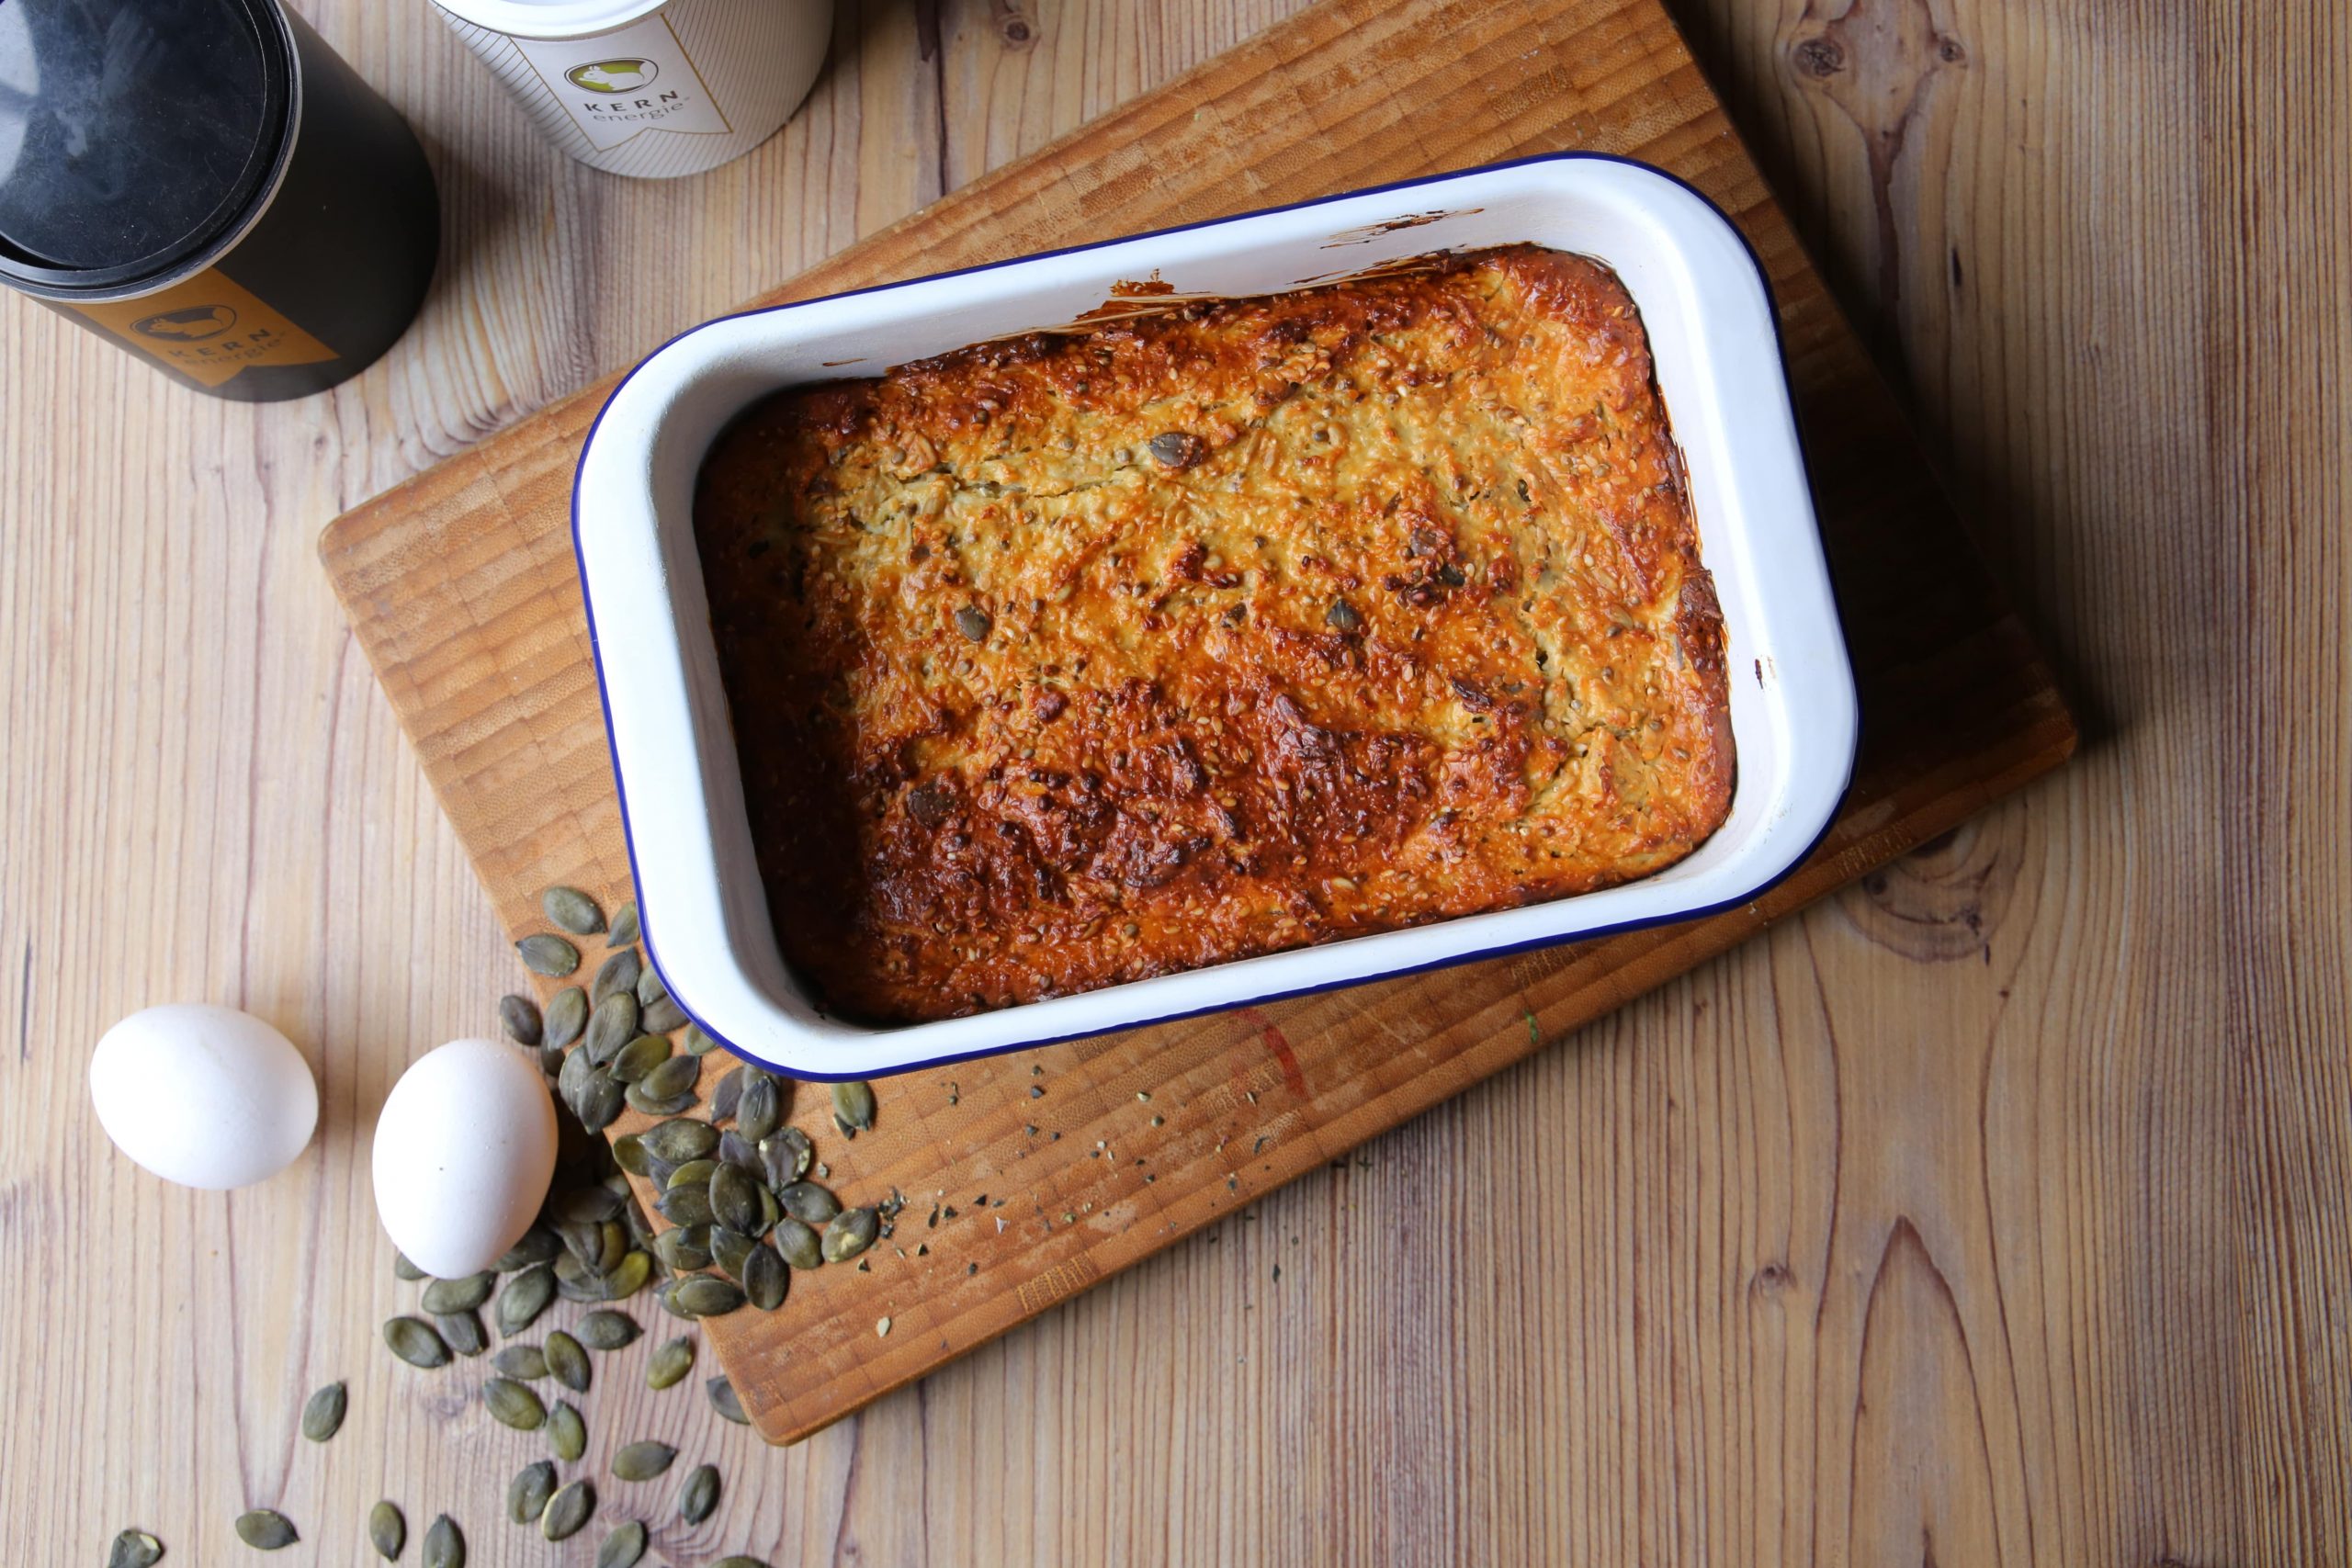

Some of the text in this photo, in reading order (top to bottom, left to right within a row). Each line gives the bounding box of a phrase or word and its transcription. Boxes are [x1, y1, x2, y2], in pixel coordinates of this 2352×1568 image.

[583, 90, 679, 112] KERN
[593, 102, 684, 121] energie
[168, 328, 272, 357] KERN
